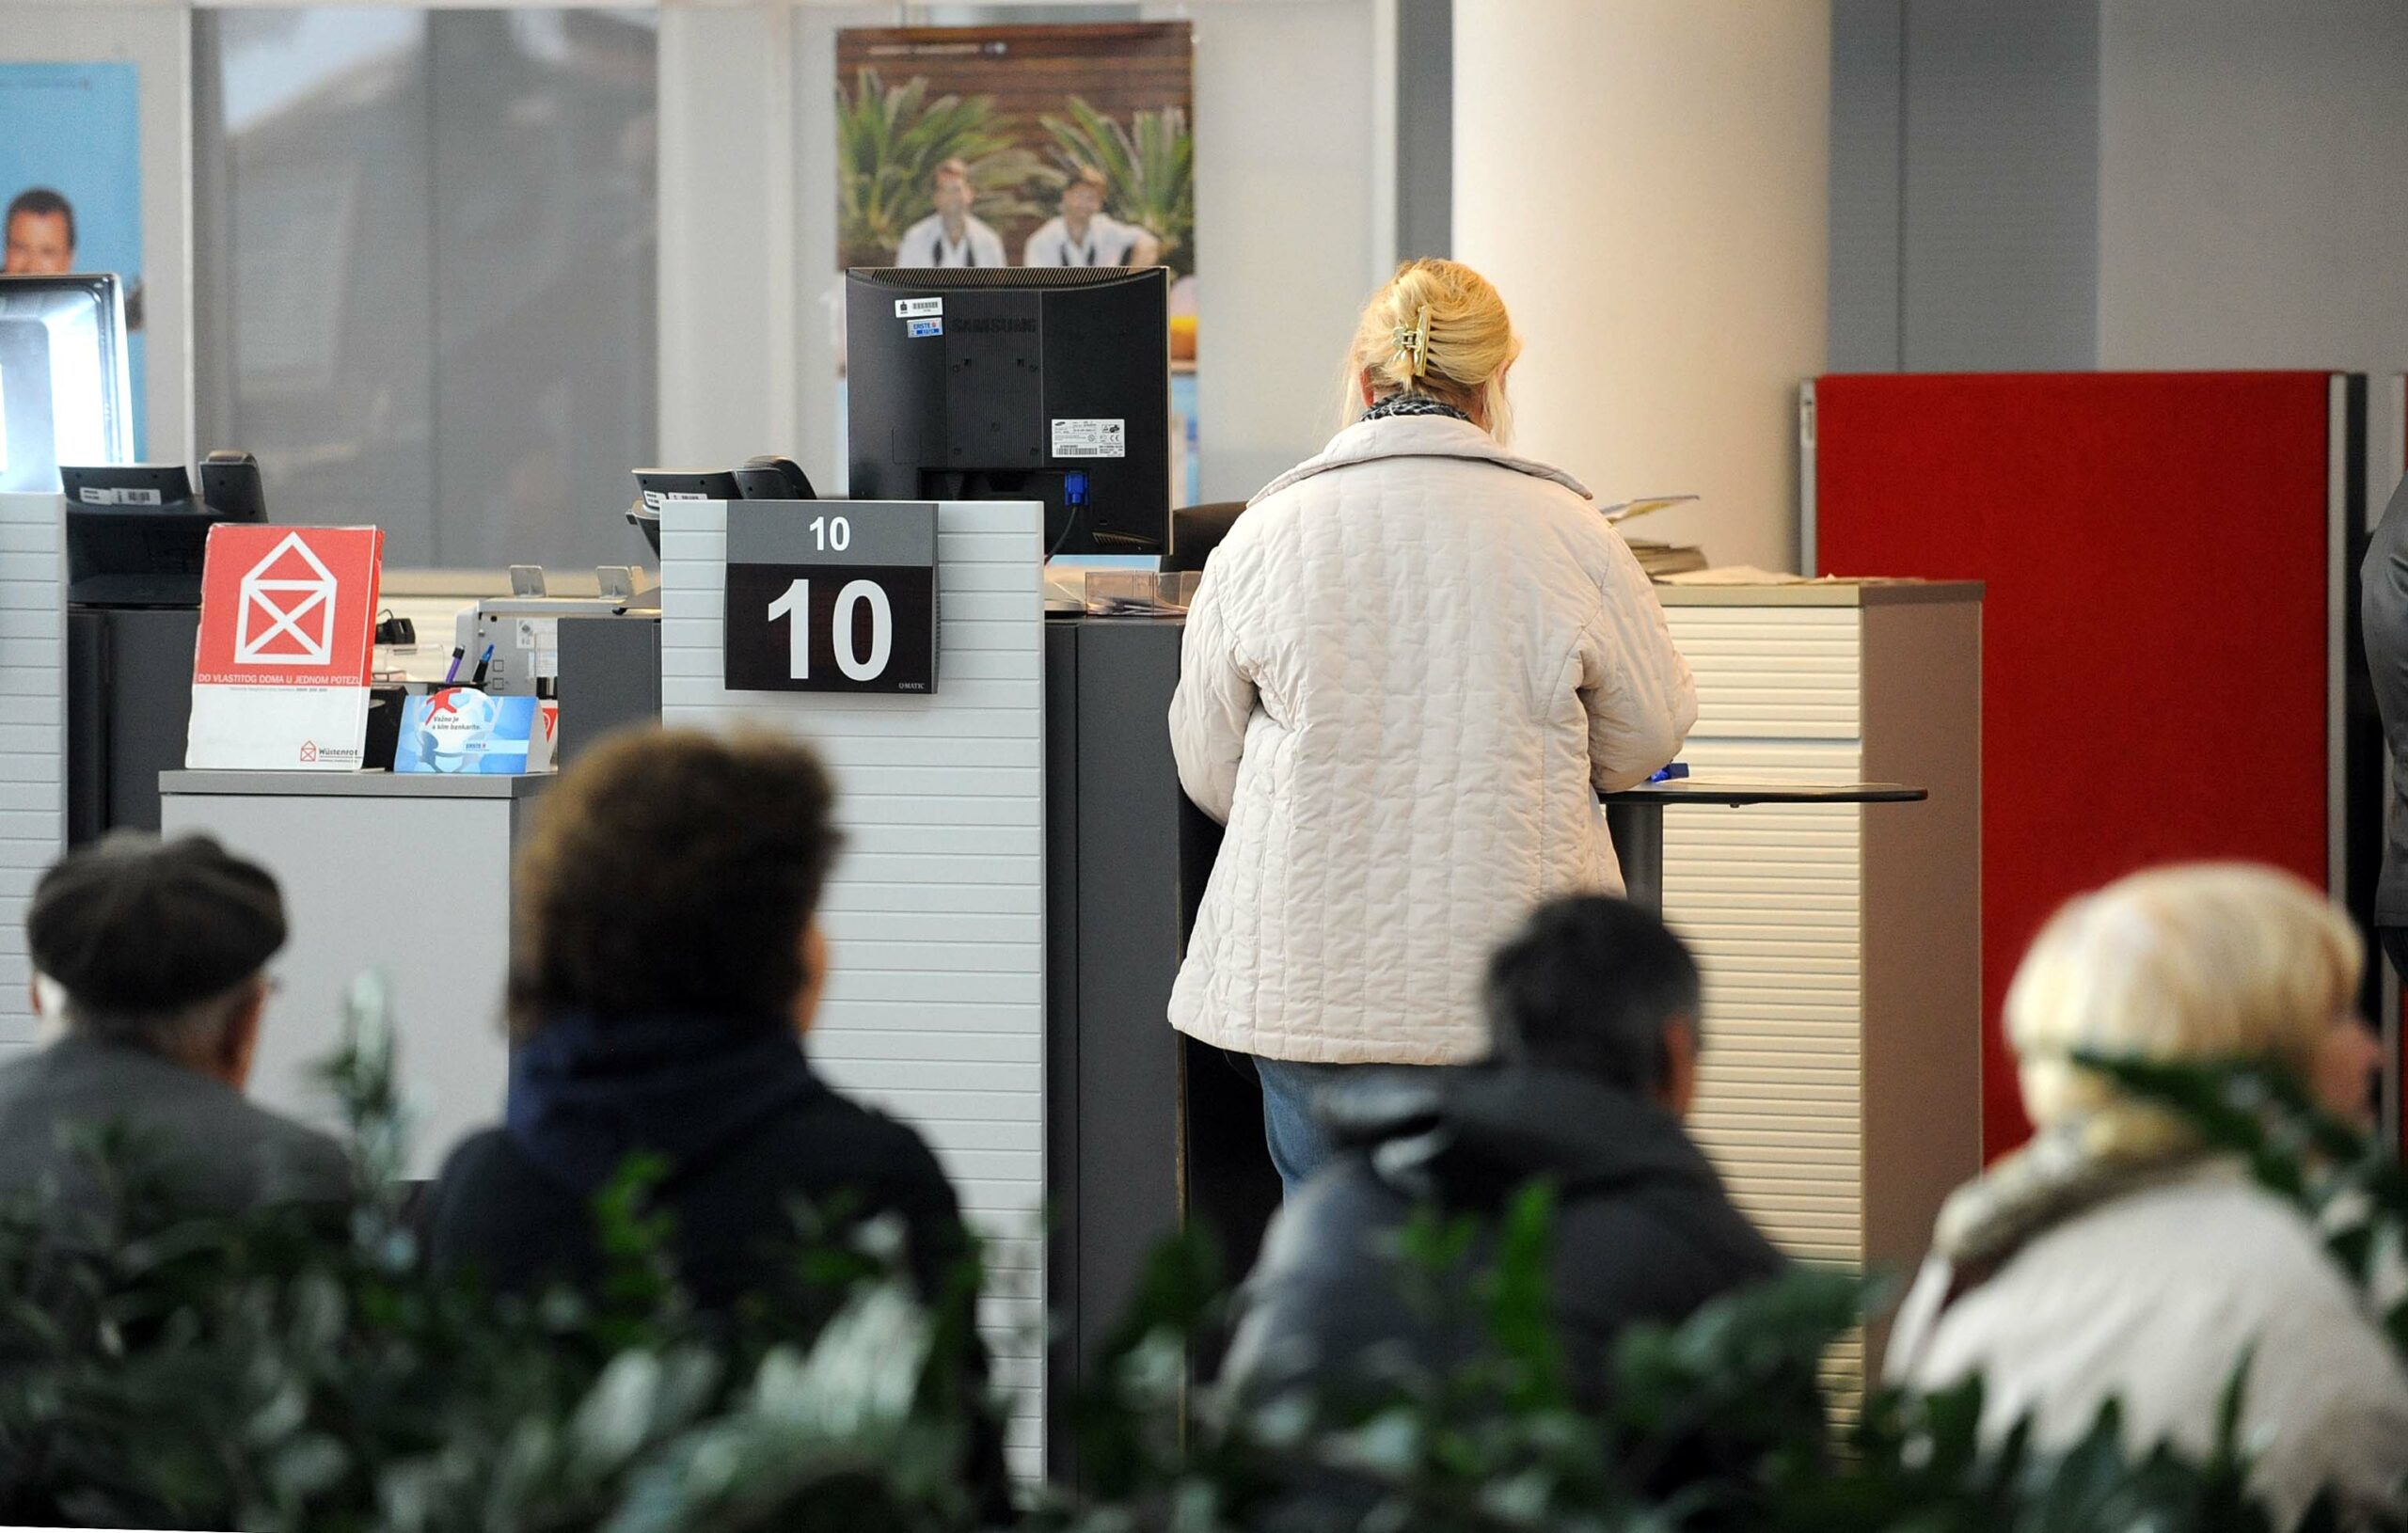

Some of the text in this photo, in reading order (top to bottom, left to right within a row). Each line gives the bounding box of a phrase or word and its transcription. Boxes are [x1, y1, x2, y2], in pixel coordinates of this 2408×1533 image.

[949, 318, 1037, 332] SAMSUNG
[809, 516, 850, 551] 10
[768, 578, 893, 682] 10
[198, 673, 361, 685] DO VLASTITOG DOMA U JEDNOM POTEZU
[319, 747, 358, 756] Wüstenrot
